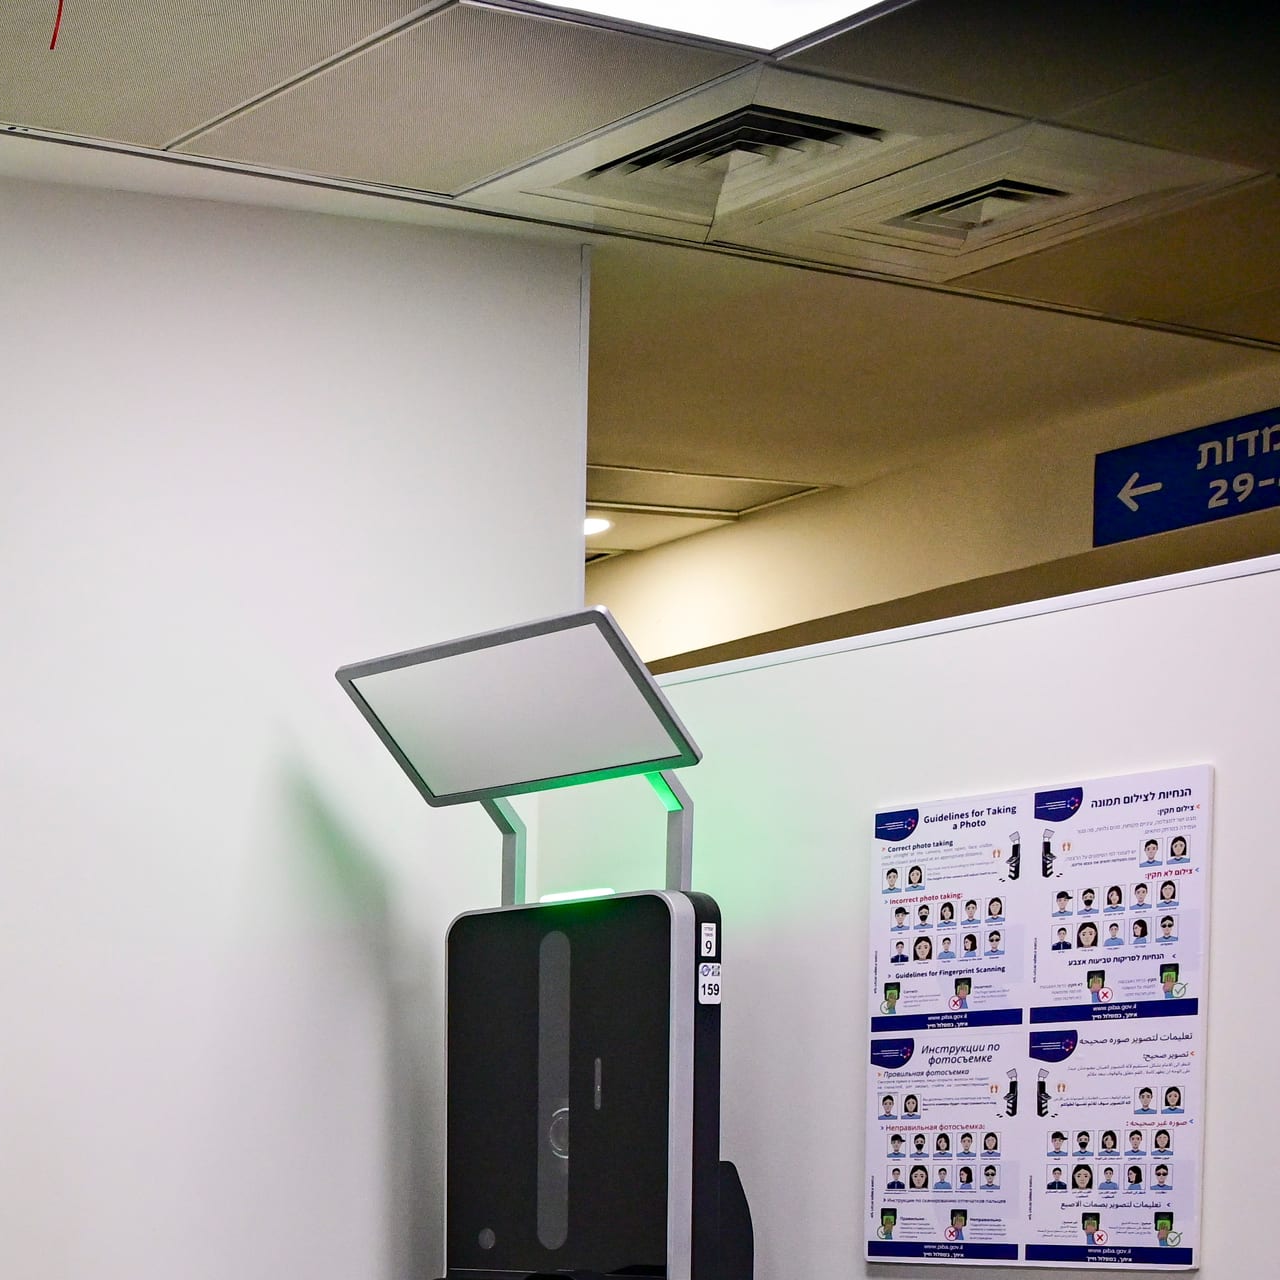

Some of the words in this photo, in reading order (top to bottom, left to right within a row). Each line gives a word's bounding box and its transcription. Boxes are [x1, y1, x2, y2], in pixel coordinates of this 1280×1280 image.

[1207, 472, 1280, 509] 29-
[923, 811, 969, 821] Guidelines
[971, 809, 984, 817] for
[986, 805, 1016, 815] Taking
[959, 819, 986, 828] Photo
[887, 844, 910, 852] Correct
[911, 842, 931, 850] photo
[932, 839, 953, 847] taking
[889, 896, 918, 904] Incorrect
[919, 895, 938, 903] photo
[705, 940, 713, 954] 9
[895, 971, 927, 979] Guidelines
[938, 968, 974, 976] Fingerprint
[975, 965, 1005, 973] Scanning
[701, 983, 720, 996] 159
